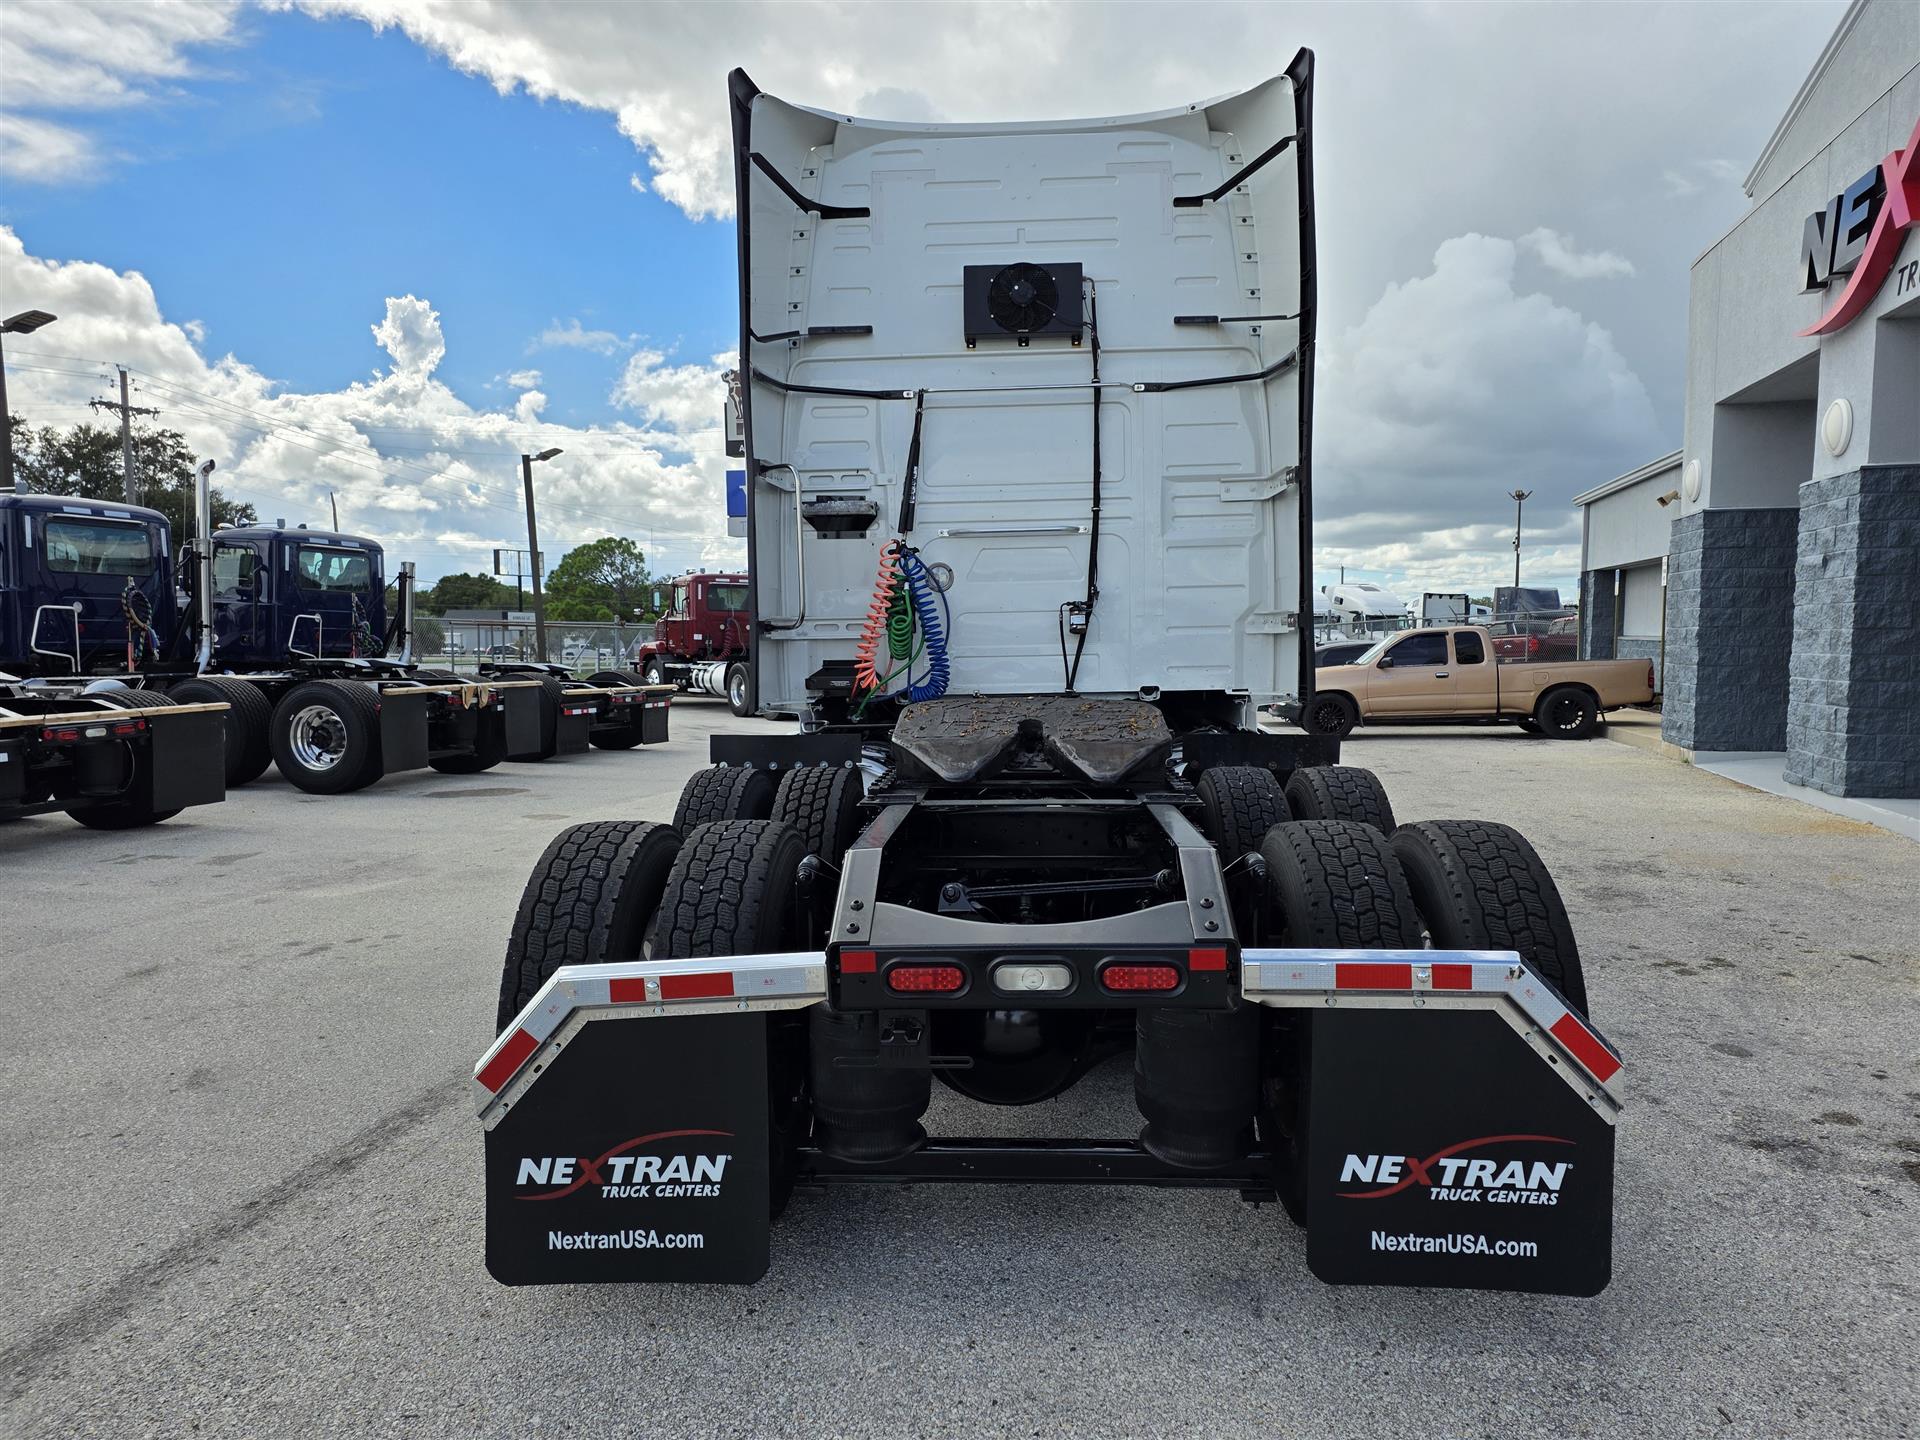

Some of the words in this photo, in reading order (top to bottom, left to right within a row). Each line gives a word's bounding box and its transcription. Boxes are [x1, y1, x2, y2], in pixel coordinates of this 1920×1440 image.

[601, 1185, 650, 1199] TRUCK
[655, 1184, 721, 1197] CENTERS
[1430, 1187, 1483, 1202] TRUCK
[1487, 1189, 1559, 1206] CENTERS
[548, 1229, 704, 1251] NextranUSA.com
[1371, 1230, 1538, 1257] NextranUSA.com
